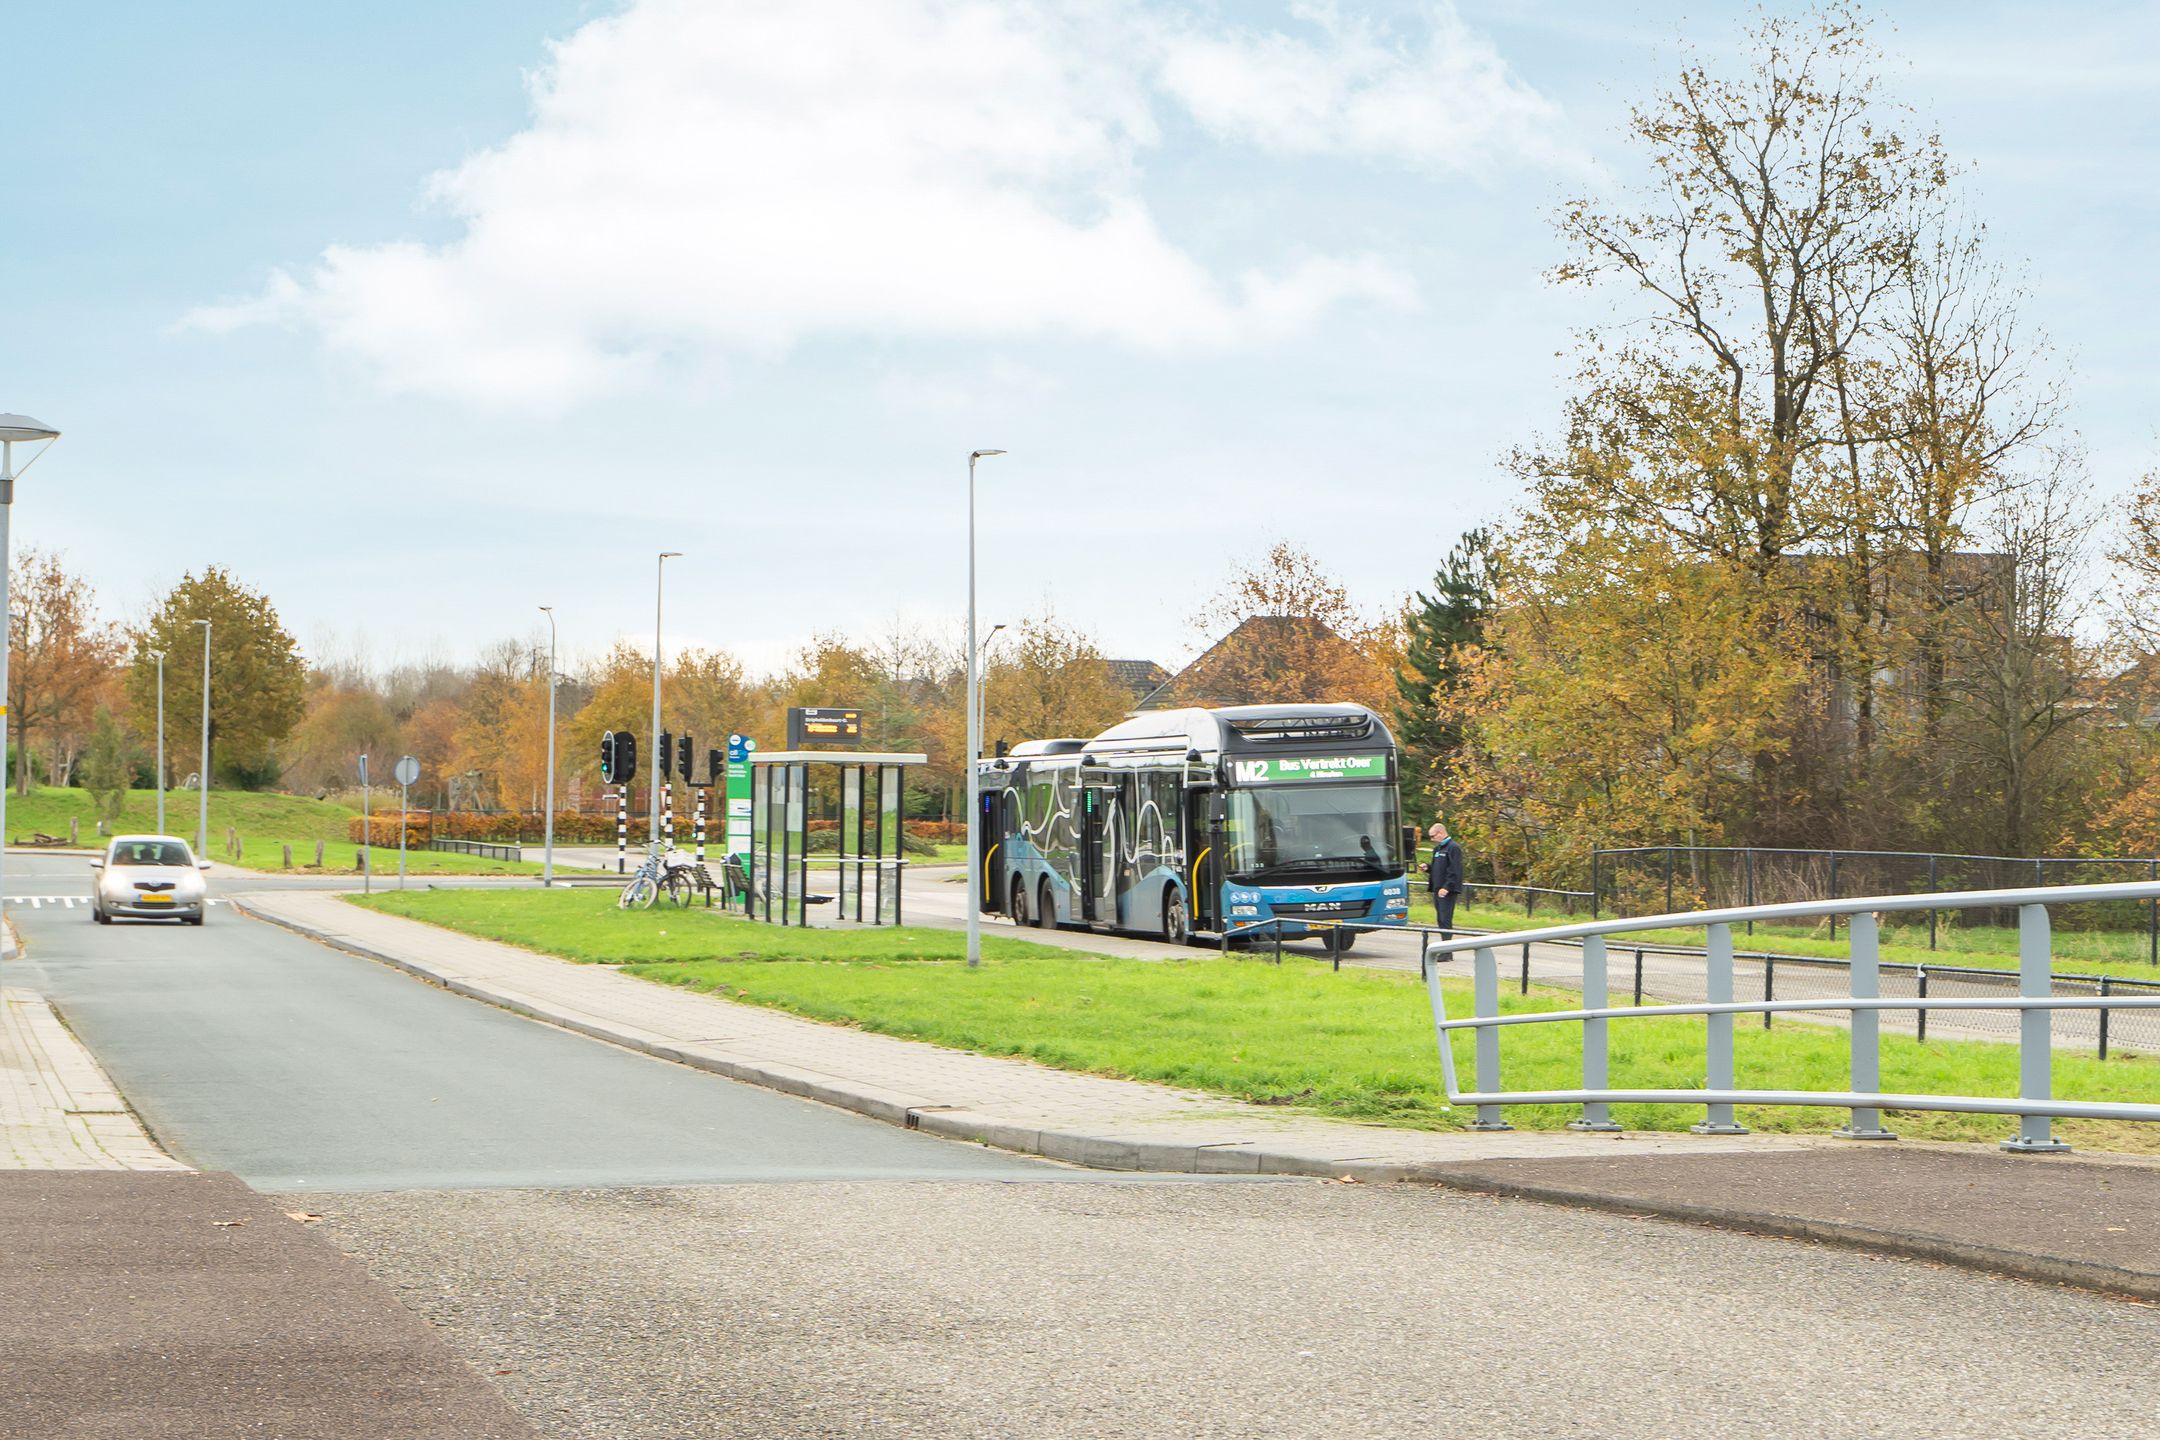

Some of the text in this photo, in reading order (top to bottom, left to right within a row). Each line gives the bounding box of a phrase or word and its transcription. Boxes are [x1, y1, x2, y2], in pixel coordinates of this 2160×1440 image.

[1236, 757, 1372, 781] M2 Bus Vertrekt Over
[1304, 902, 1342, 911] MAN
